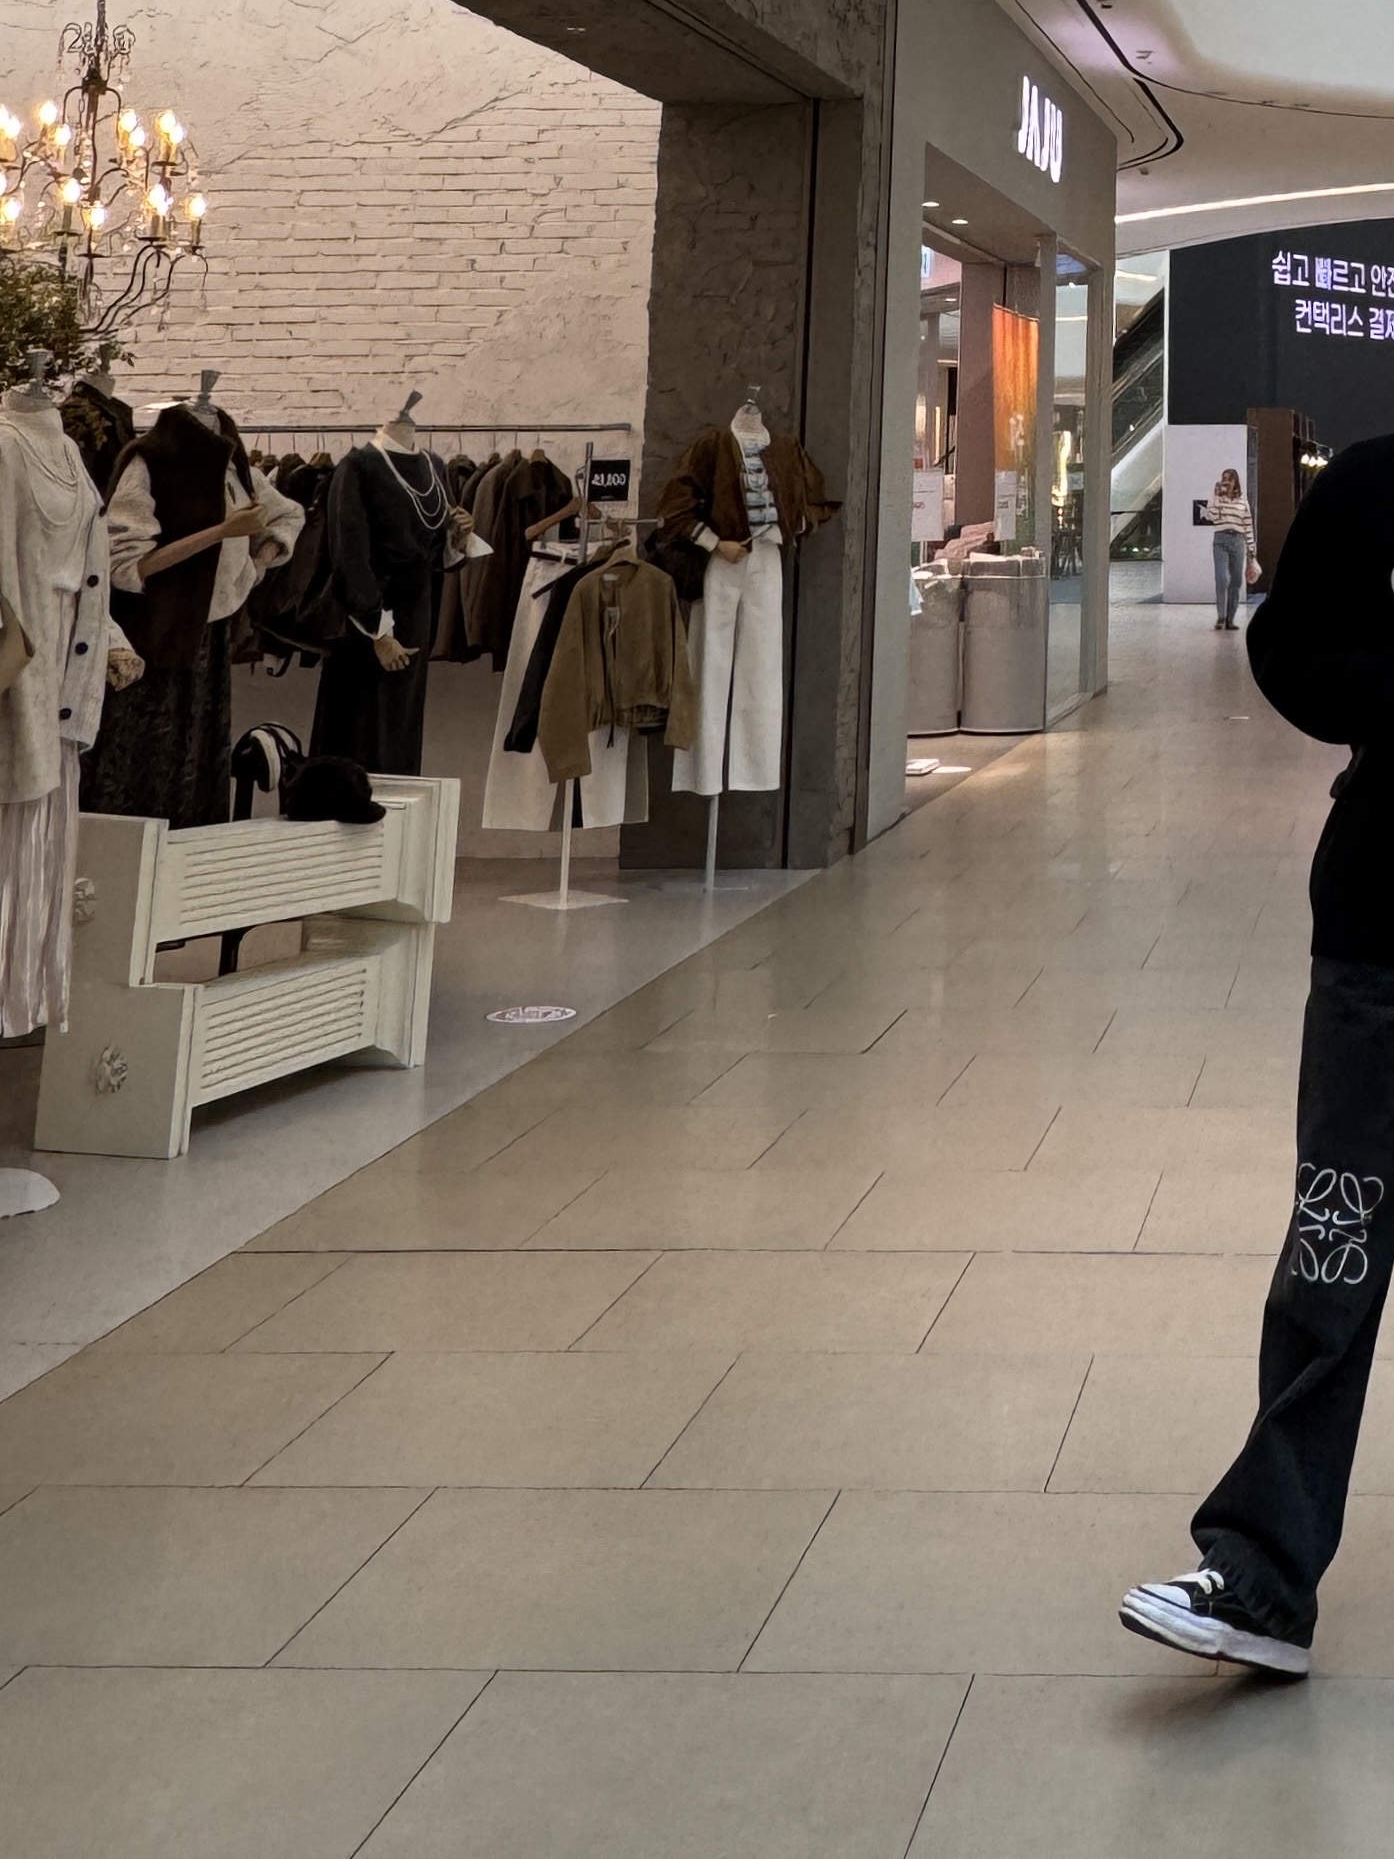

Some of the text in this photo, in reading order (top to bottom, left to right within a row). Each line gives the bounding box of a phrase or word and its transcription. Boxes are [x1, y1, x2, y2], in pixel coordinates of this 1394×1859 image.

[1017, 75, 1063, 183] JAJU
[1272, 250, 1310, 287] 쉽고
[1314, 256, 1366, 294] 빠르고
[1294, 299, 1364, 337] 컨택리스
